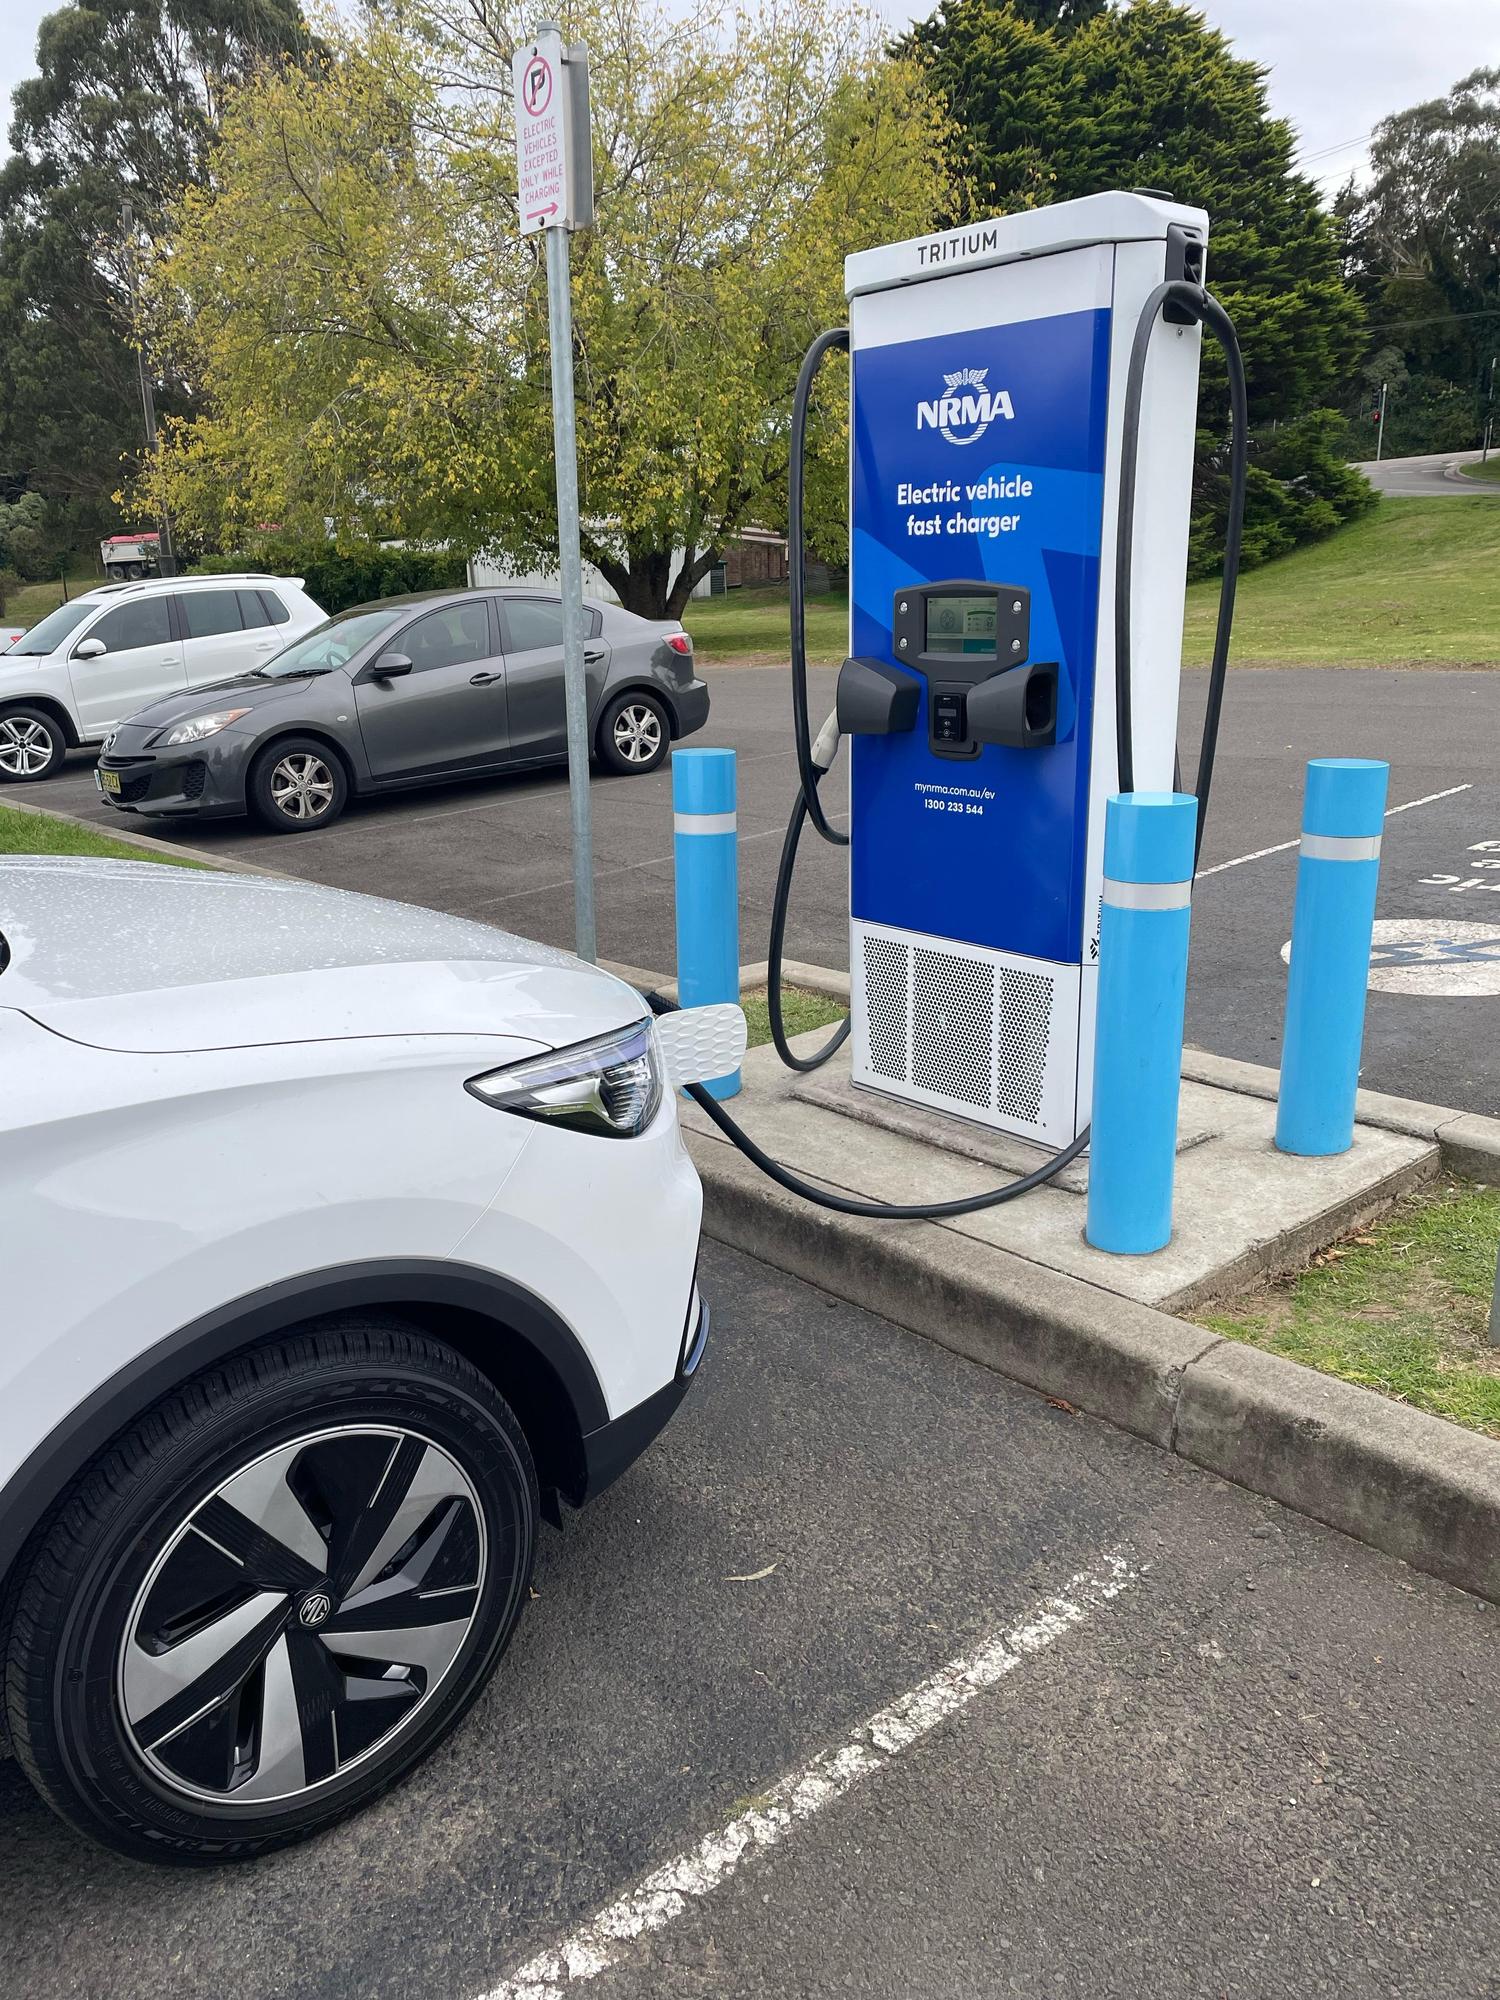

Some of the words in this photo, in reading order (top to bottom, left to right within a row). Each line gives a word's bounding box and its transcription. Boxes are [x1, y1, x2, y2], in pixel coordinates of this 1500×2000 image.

[523, 117, 555, 138] ELECTRIC
[524, 133, 557, 156] VEHICLES
[524, 149, 558, 173] EXCEPTED
[520, 173, 539, 190] ONLY
[542, 163, 563, 182] WHILE
[525, 182, 560, 204] CHARGING
[917, 229, 998, 266] TRITIUM
[916, 390, 1015, 430] NRMA
[897, 480, 961, 505] Electric
[966, 474, 1033, 501] vehicle
[906, 515, 942, 536] fast
[946, 512, 1020, 538] charger
[914, 781, 996, 800] mynrma.com.au/ev
[924, 799, 945, 811] 1300
[947, 801, 964, 813] 233
[966, 803, 984, 816] 544
[303, 1598, 328, 1624] MG
